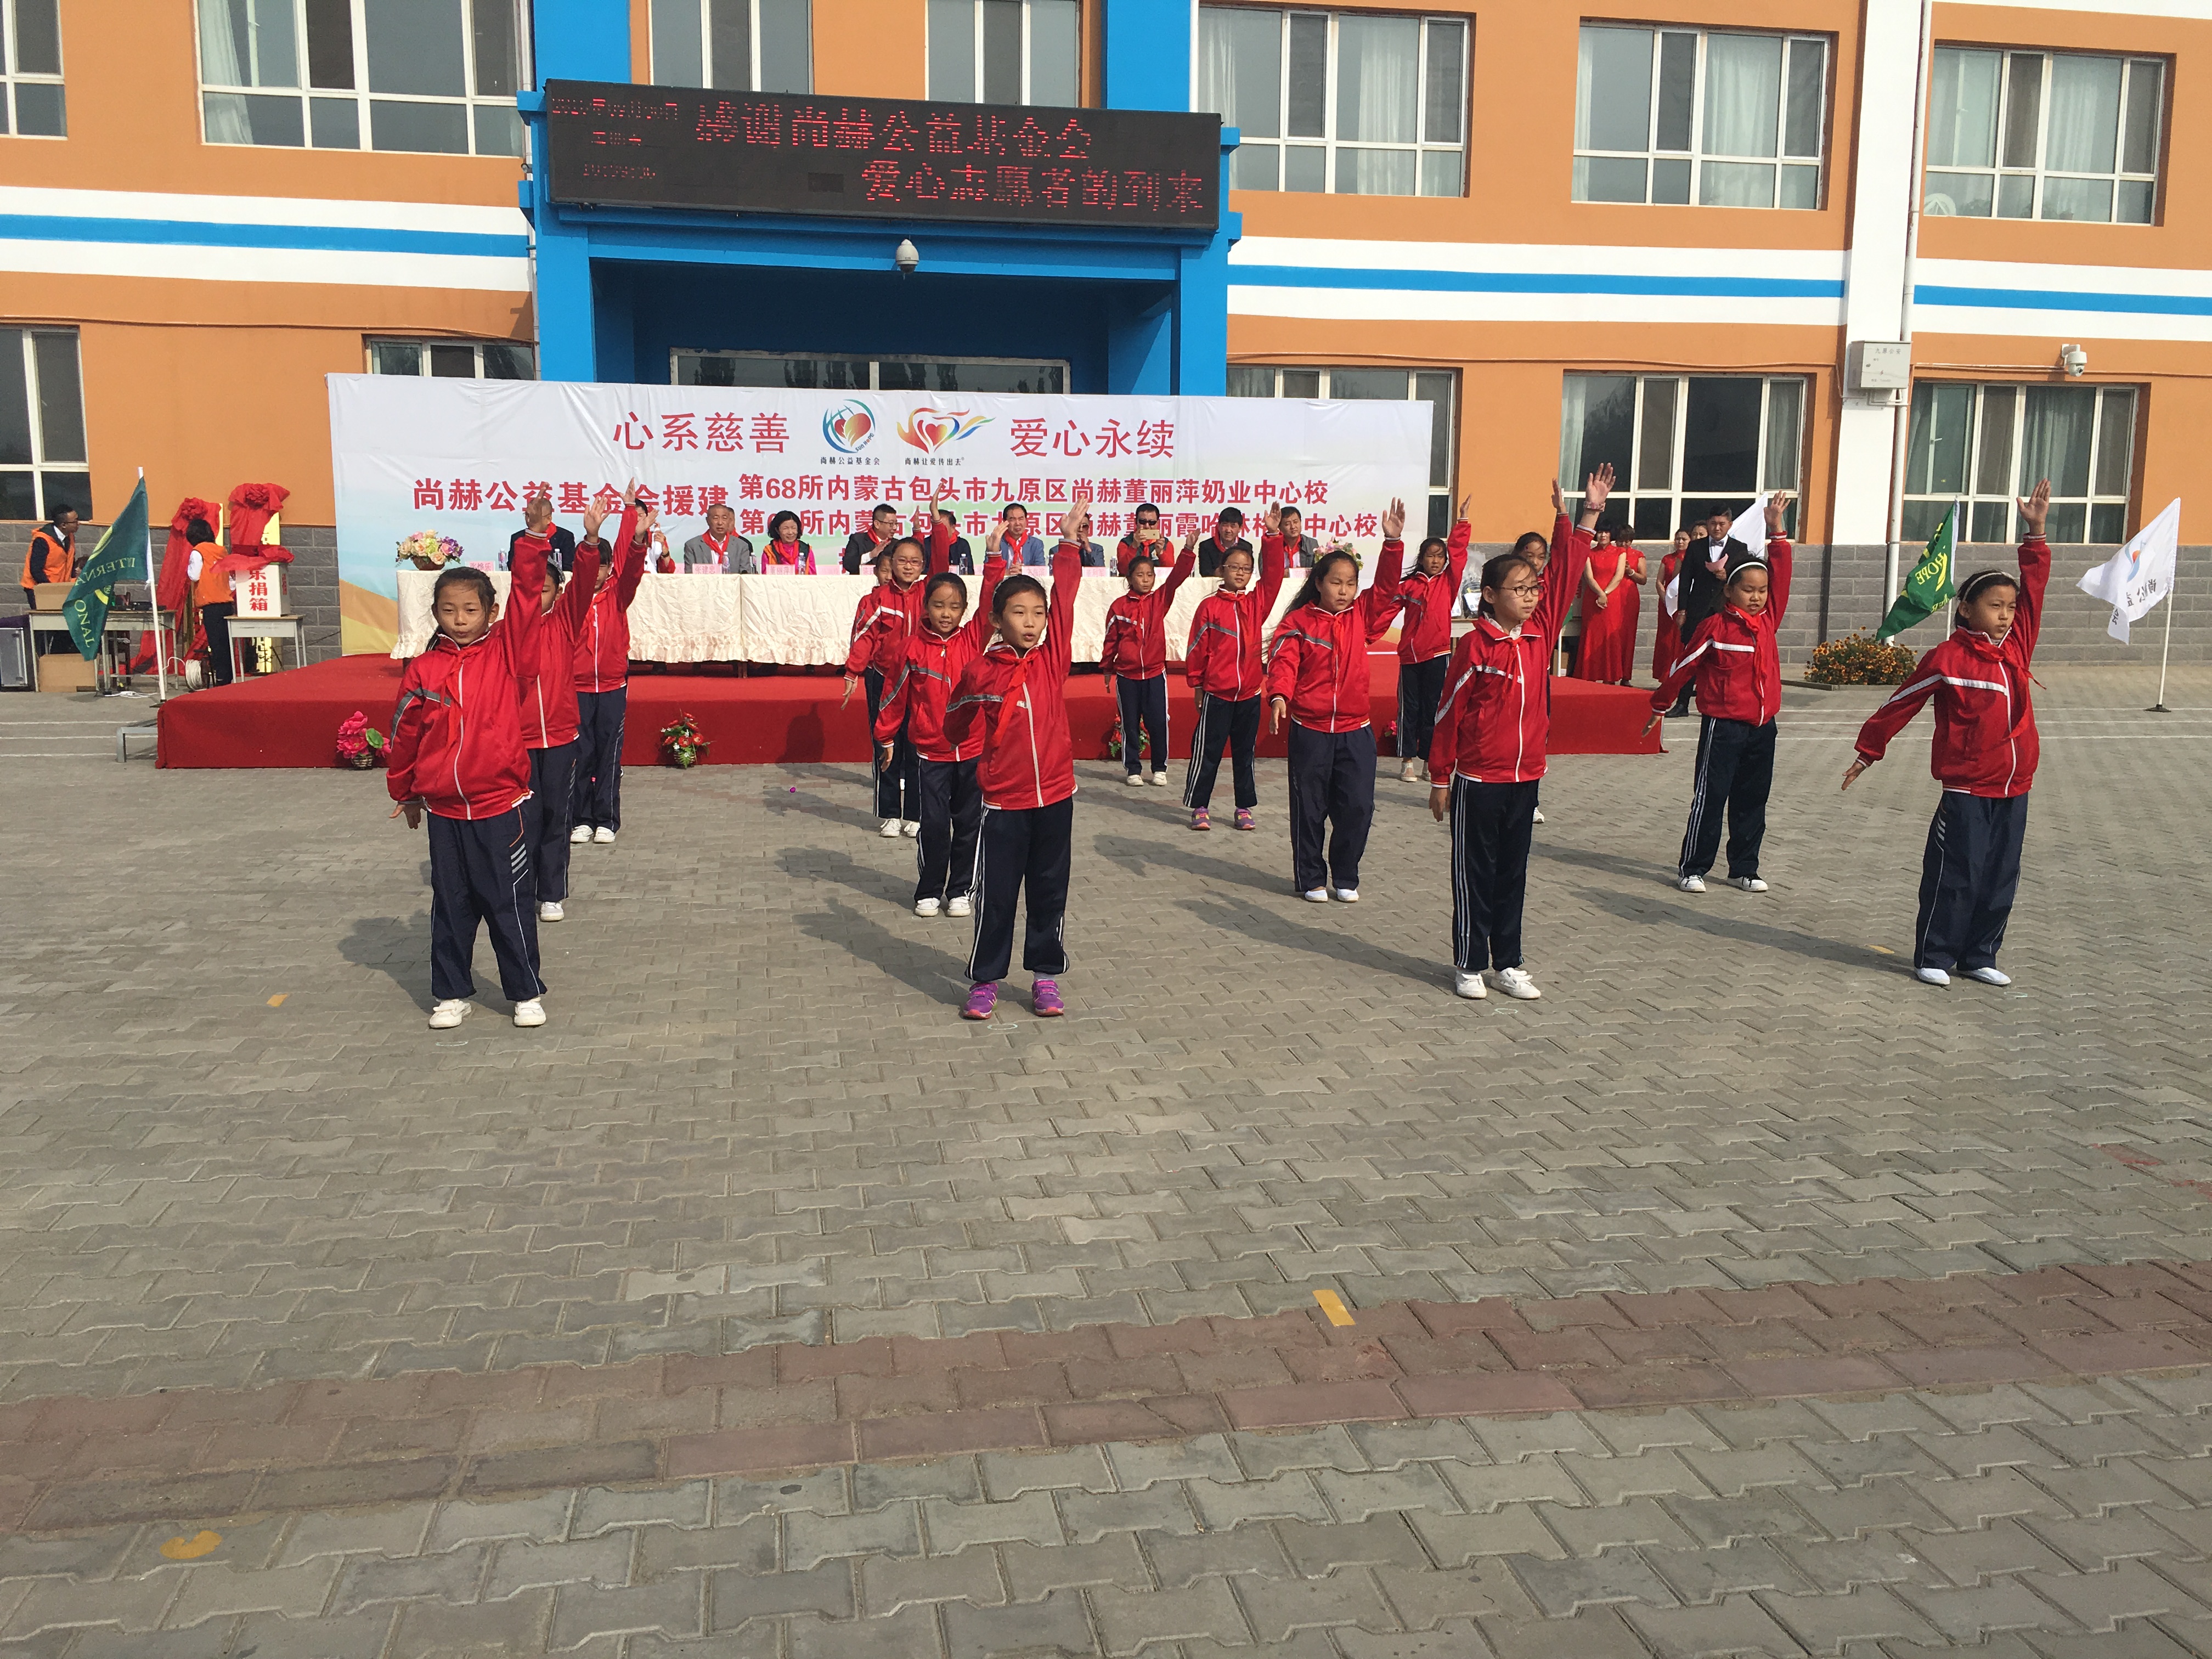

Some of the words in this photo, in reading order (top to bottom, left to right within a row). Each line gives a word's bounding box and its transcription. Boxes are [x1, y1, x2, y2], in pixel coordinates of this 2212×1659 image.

[862, 160, 1203, 212] 爱心志愿者的到来
[614, 411, 790, 453] 心系慈善
[1010, 418, 1174, 459] 爱心永续
[820, 457, 880, 465] 尚赫公益基金会
[905, 458, 961, 466] 尚赫让爱传出去
[414, 478, 729, 516] 尚赫公益基金会援建
[740, 474, 1328, 505] 第68所内蒙古包头市九原区尚赫董丽萍奶业中心校
